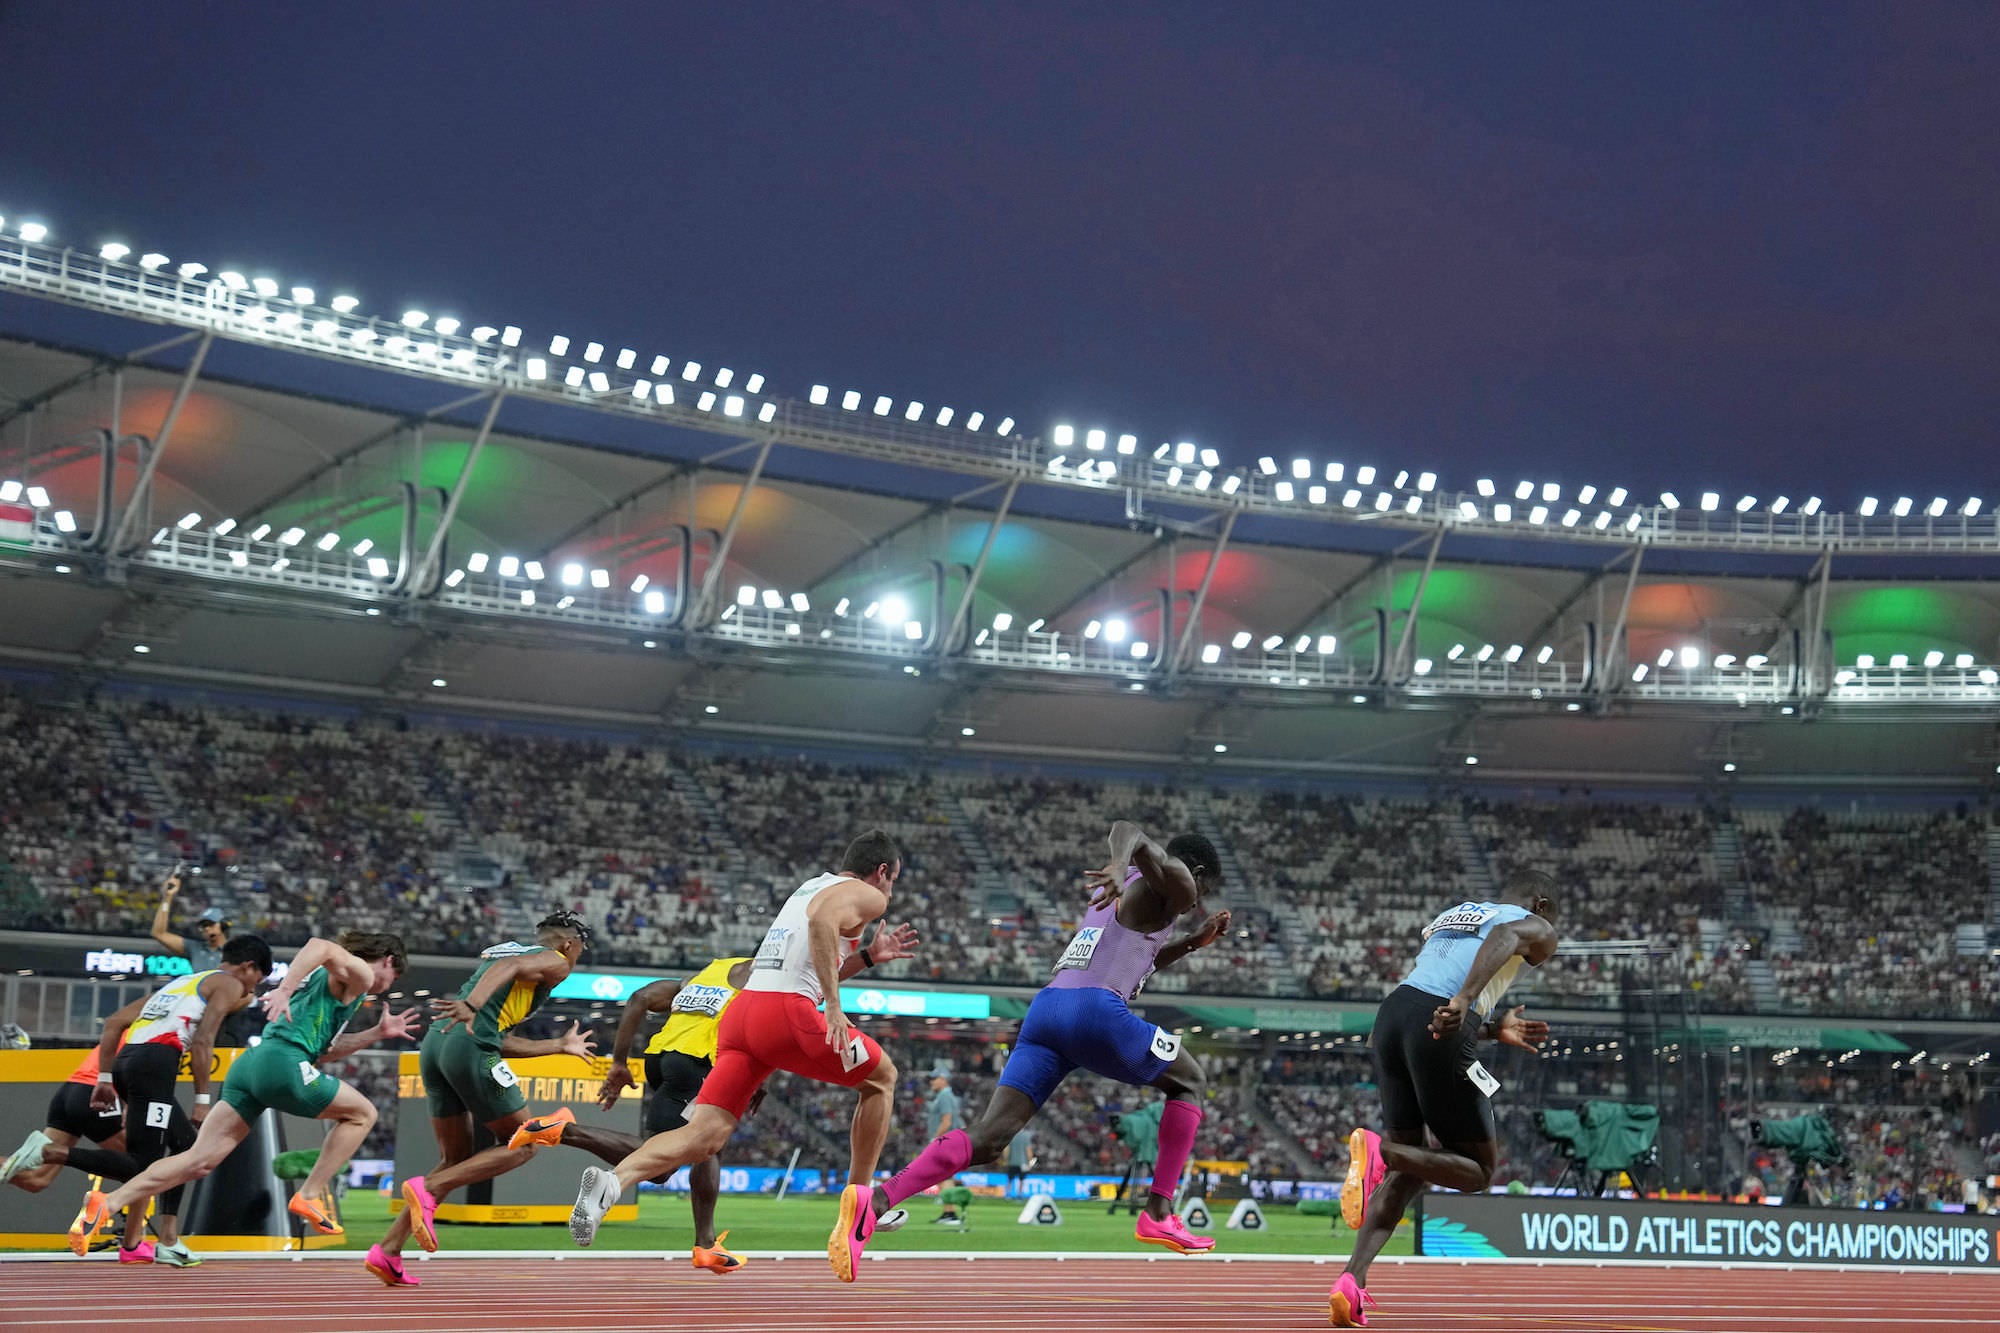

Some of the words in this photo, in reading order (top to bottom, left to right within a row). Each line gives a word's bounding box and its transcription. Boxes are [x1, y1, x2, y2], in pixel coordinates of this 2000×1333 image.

[1459, 903, 1488, 915] DK
[1436, 913, 1482, 926] BOGO
[767, 928, 790, 940] TDK
[694, 985, 729, 998] TDK
[674, 995, 721, 1006] GREENE
[498, 1065, 513, 1082] 5
[1475, 1066, 1493, 1088] 9
[155, 1106, 165, 1124] 3
[1521, 1212, 1630, 1253] WORLD
[1634, 1216, 1782, 1257] ATHLETICS
[1786, 1220, 1990, 1263] CHAMPIONSHIPS
